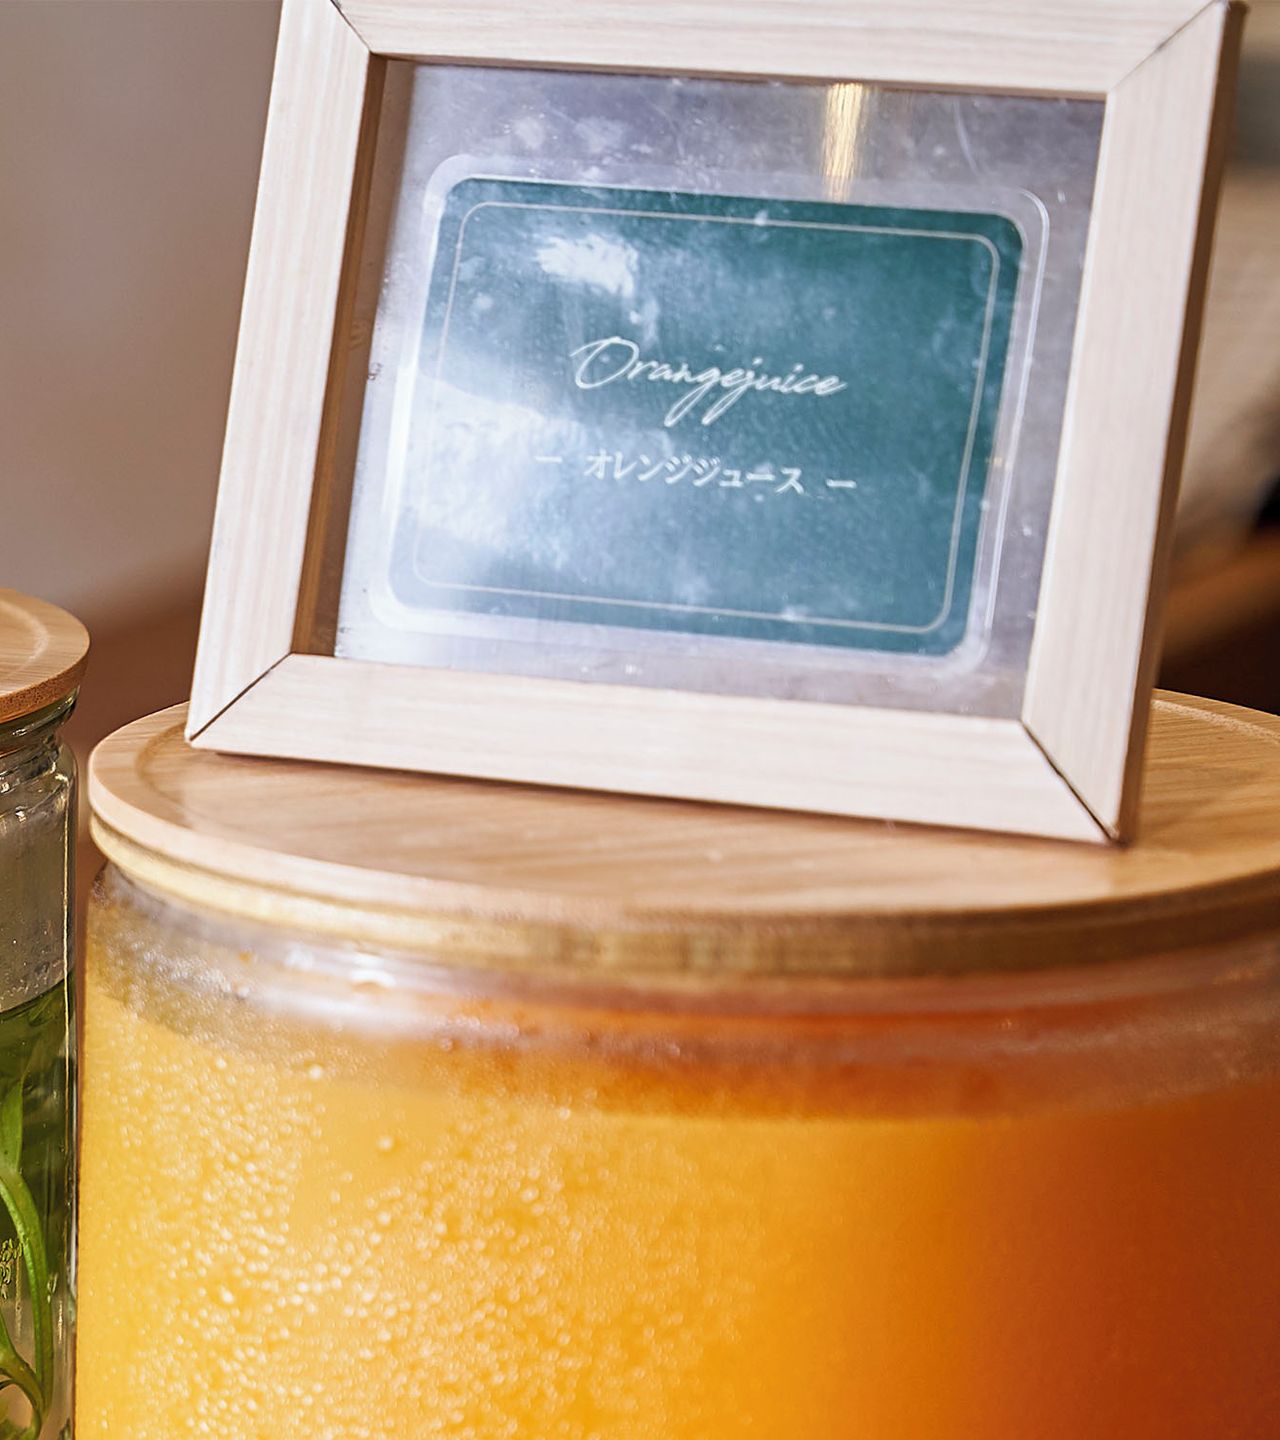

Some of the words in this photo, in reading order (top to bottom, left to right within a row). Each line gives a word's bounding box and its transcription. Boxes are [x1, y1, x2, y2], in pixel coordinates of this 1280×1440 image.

[570, 335, 848, 428] Orangejuice
[583, 449, 806, 495] オレンジジュース
